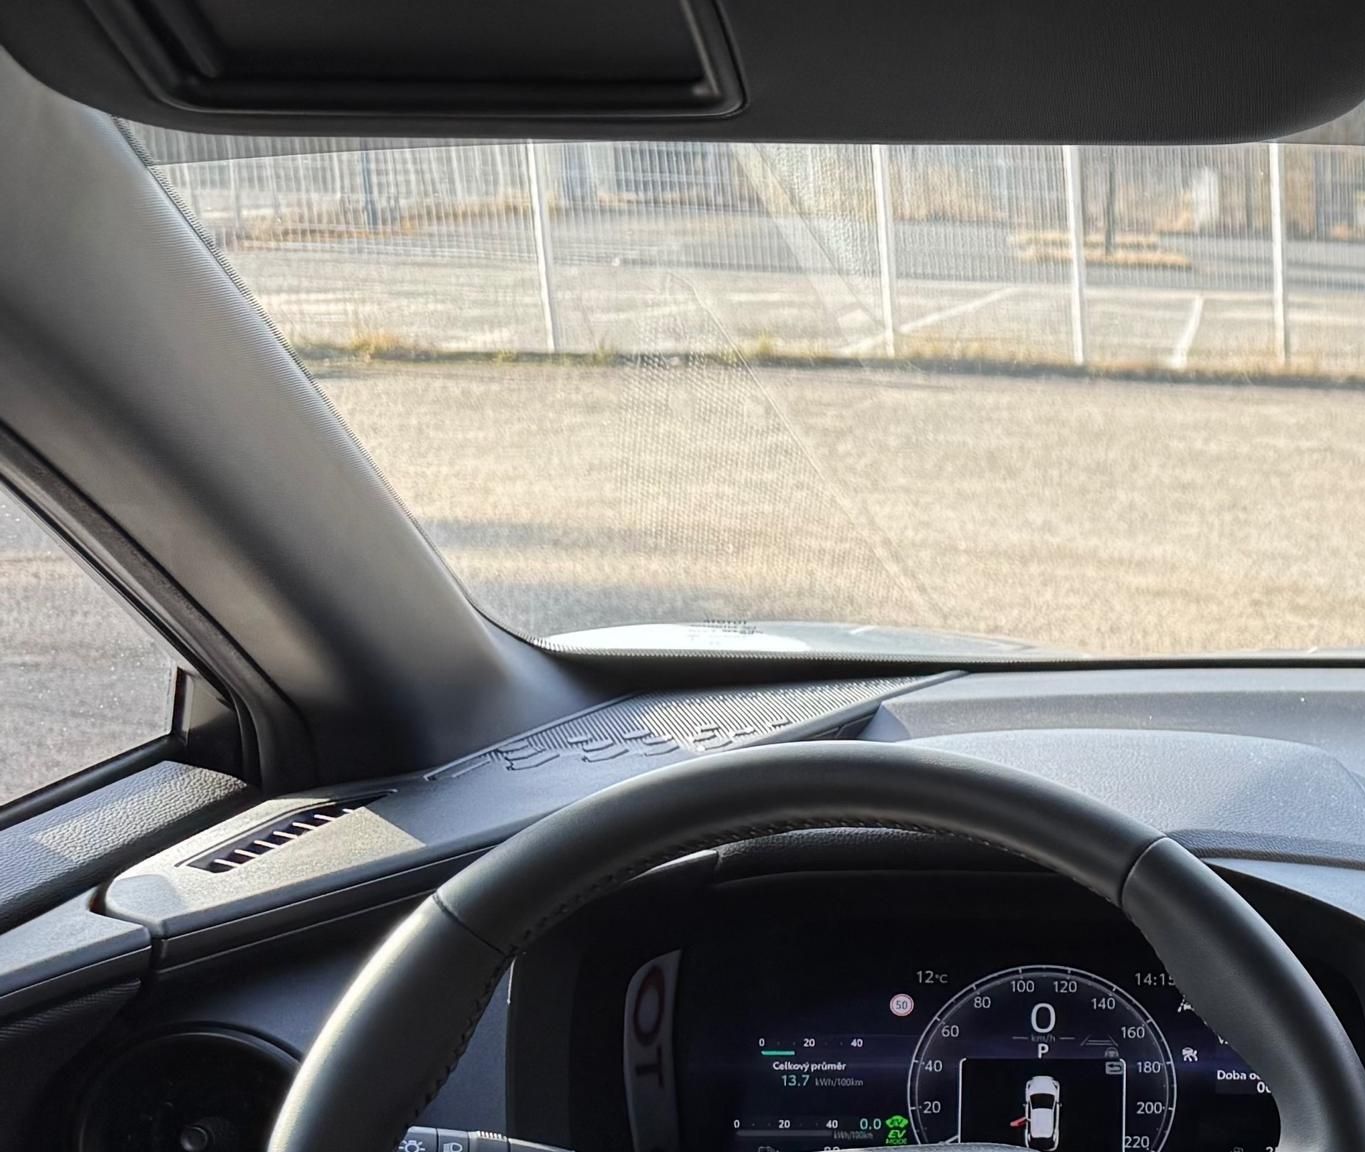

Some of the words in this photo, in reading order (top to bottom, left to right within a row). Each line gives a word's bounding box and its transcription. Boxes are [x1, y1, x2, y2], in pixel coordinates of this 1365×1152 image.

[1135, 973, 1175, 986] 14:15
[1010, 980, 1035, 993] 100
[1053, 980, 1077, 993] 120
[896, 1000, 908, 1010] 50
[973, 997, 991, 1008] 80
[1091, 998, 1116, 1009] 140
[1031, 1003, 1056, 1033] 0
[941, 1025, 959, 1037] 60
[1121, 1026, 1145, 1039] 160
[759, 1039, 765, 1047] 0
[803, 1039, 815, 1047] 20
[850, 1039, 863, 1047] 40
[1031, 1035, 1056, 1043] km/h
[1037, 1043, 1049, 1059] P
[772, 1061, 809, 1072] Celkový
[811, 1061, 846, 1072] průměr
[924, 1060, 943, 1072] 40
[1137, 1061, 1161, 1073] 180
[781, 1074, 810, 1086] 13.7
[815, 1077, 864, 1087] kWh/100km
[1217, 1070, 1246, 1080] Doba
[923, 1101, 941, 1114] 20
[1136, 1102, 1162, 1114] 200
[734, 1120, 740, 1128] 0
[778, 1120, 790, 1128] 20
[826, 1120, 838, 1128] 40
[859, 1118, 881, 1130] 0.0
[888, 1130, 906, 1138] EV
[1125, 1136, 1150, 1148] 220
